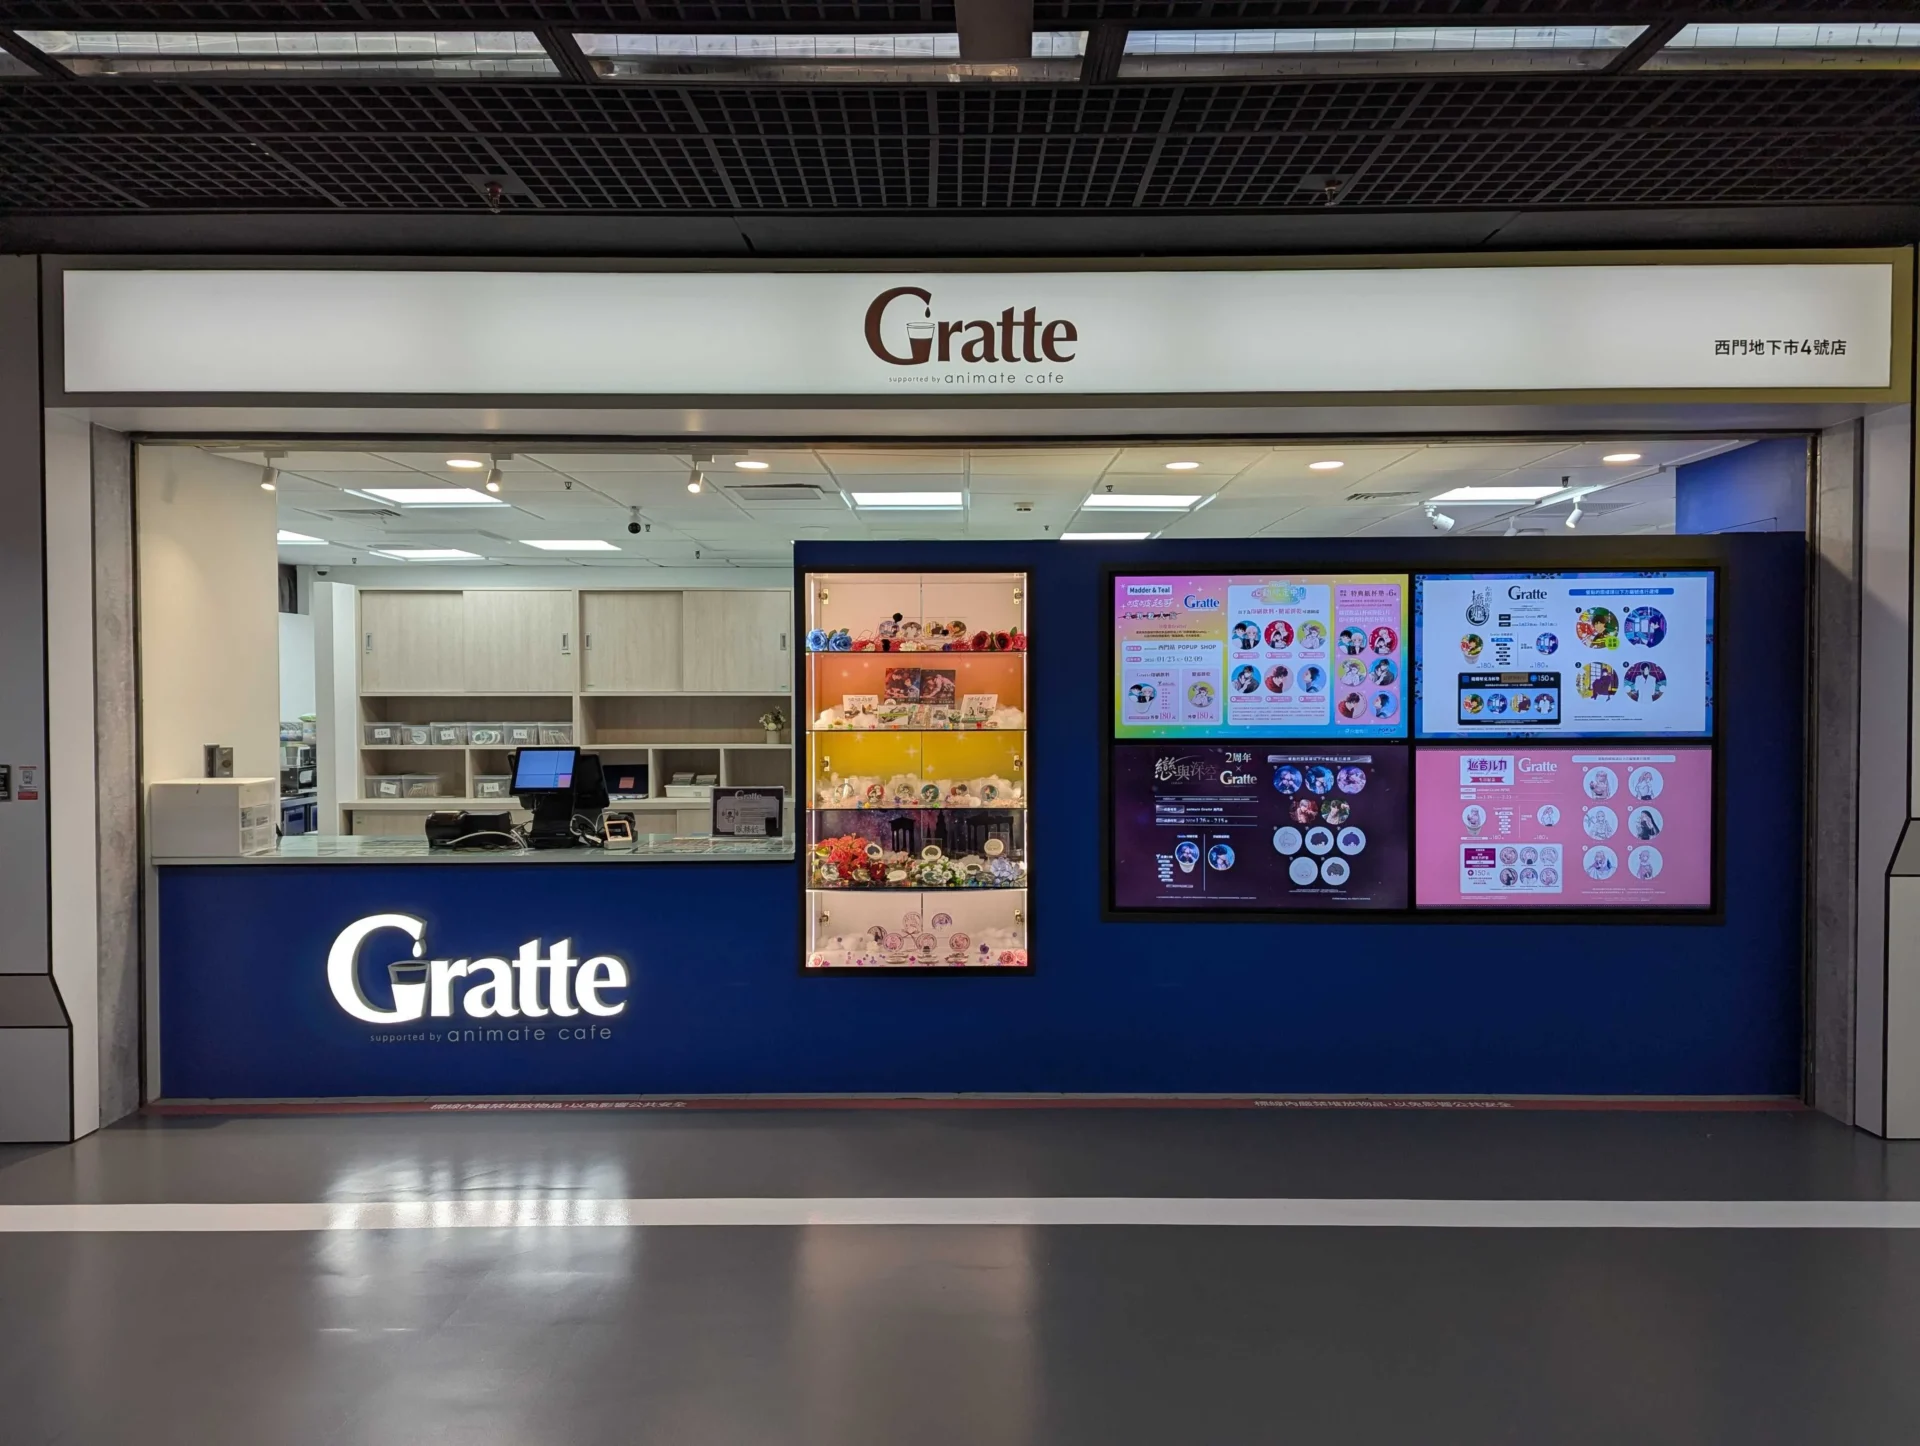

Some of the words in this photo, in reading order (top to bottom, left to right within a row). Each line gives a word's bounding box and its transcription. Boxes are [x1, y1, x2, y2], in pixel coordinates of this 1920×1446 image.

[864, 286, 1078, 365] Gratte
[1714, 339, 1847, 356] 西門地下市4號店
[888, 375, 929, 383] supported
[931, 375, 941, 383] by
[945, 372, 1016, 384] animate
[1025, 371, 1064, 384] cafe
[1508, 585, 1548, 600] Gratte
[1183, 594, 1220, 608] Gratte
[1225, 752, 1252, 763] 2周年
[1467, 757, 1507, 772] 巡音ルカ
[1518, 757, 1557, 772] Gratte
[1155, 756, 1217, 781] 戀與深空
[1220, 770, 1258, 785] Gratte
[327, 913, 629, 1024] Gratte
[370, 1032, 425, 1043] supported
[429, 1032, 442, 1043] by
[447, 1025, 546, 1042] animate
[558, 1024, 612, 1041] cafe
